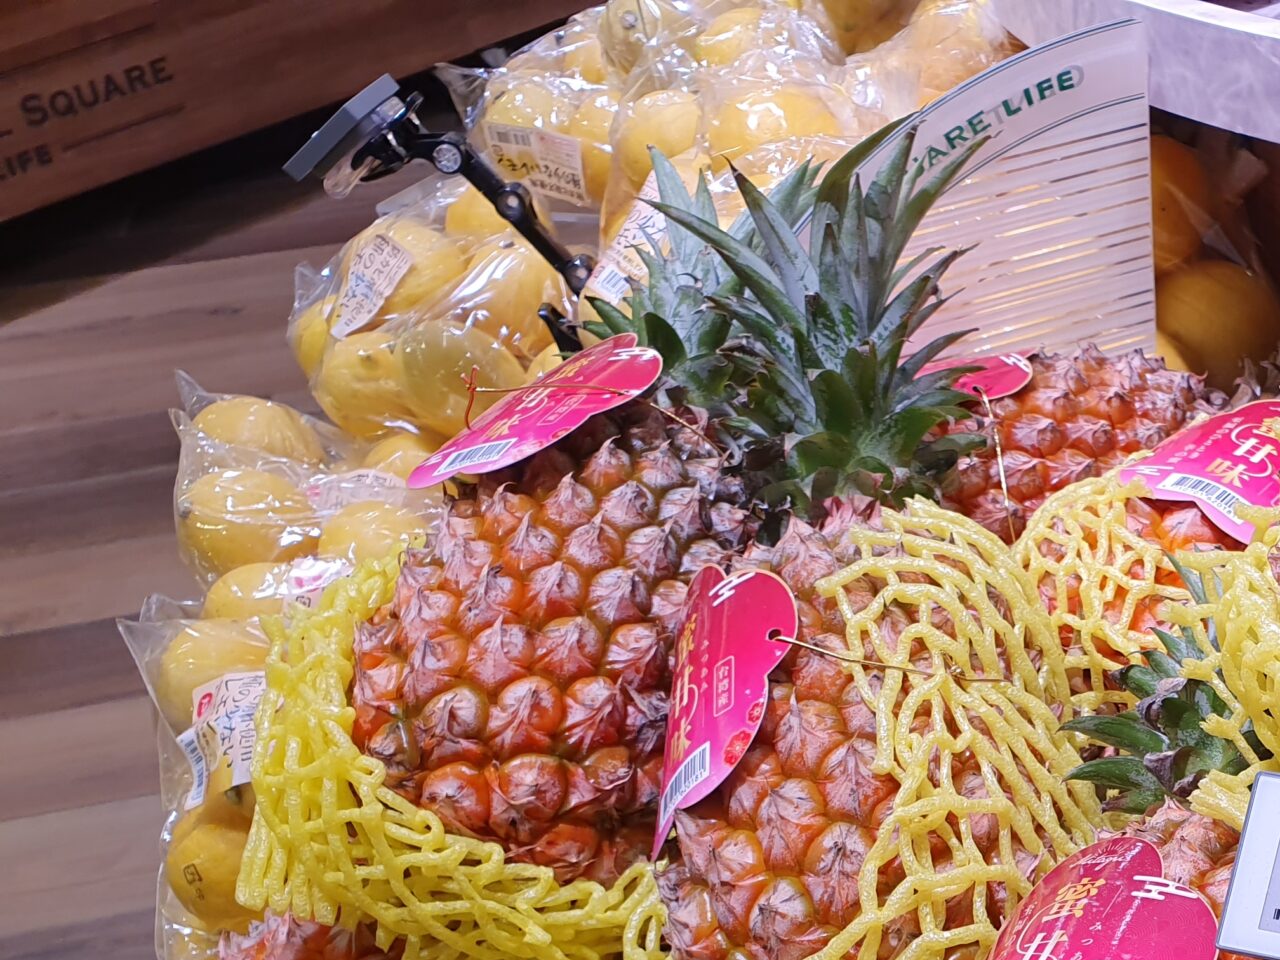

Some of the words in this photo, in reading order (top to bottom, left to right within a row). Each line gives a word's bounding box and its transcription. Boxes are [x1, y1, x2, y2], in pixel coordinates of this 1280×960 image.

[20, 55, 174, 126] SQUARE
[913, 110, 991, 168] ARE
[1001, 70, 1076, 117] LIFE
[0, 144, 53, 181] IFE
